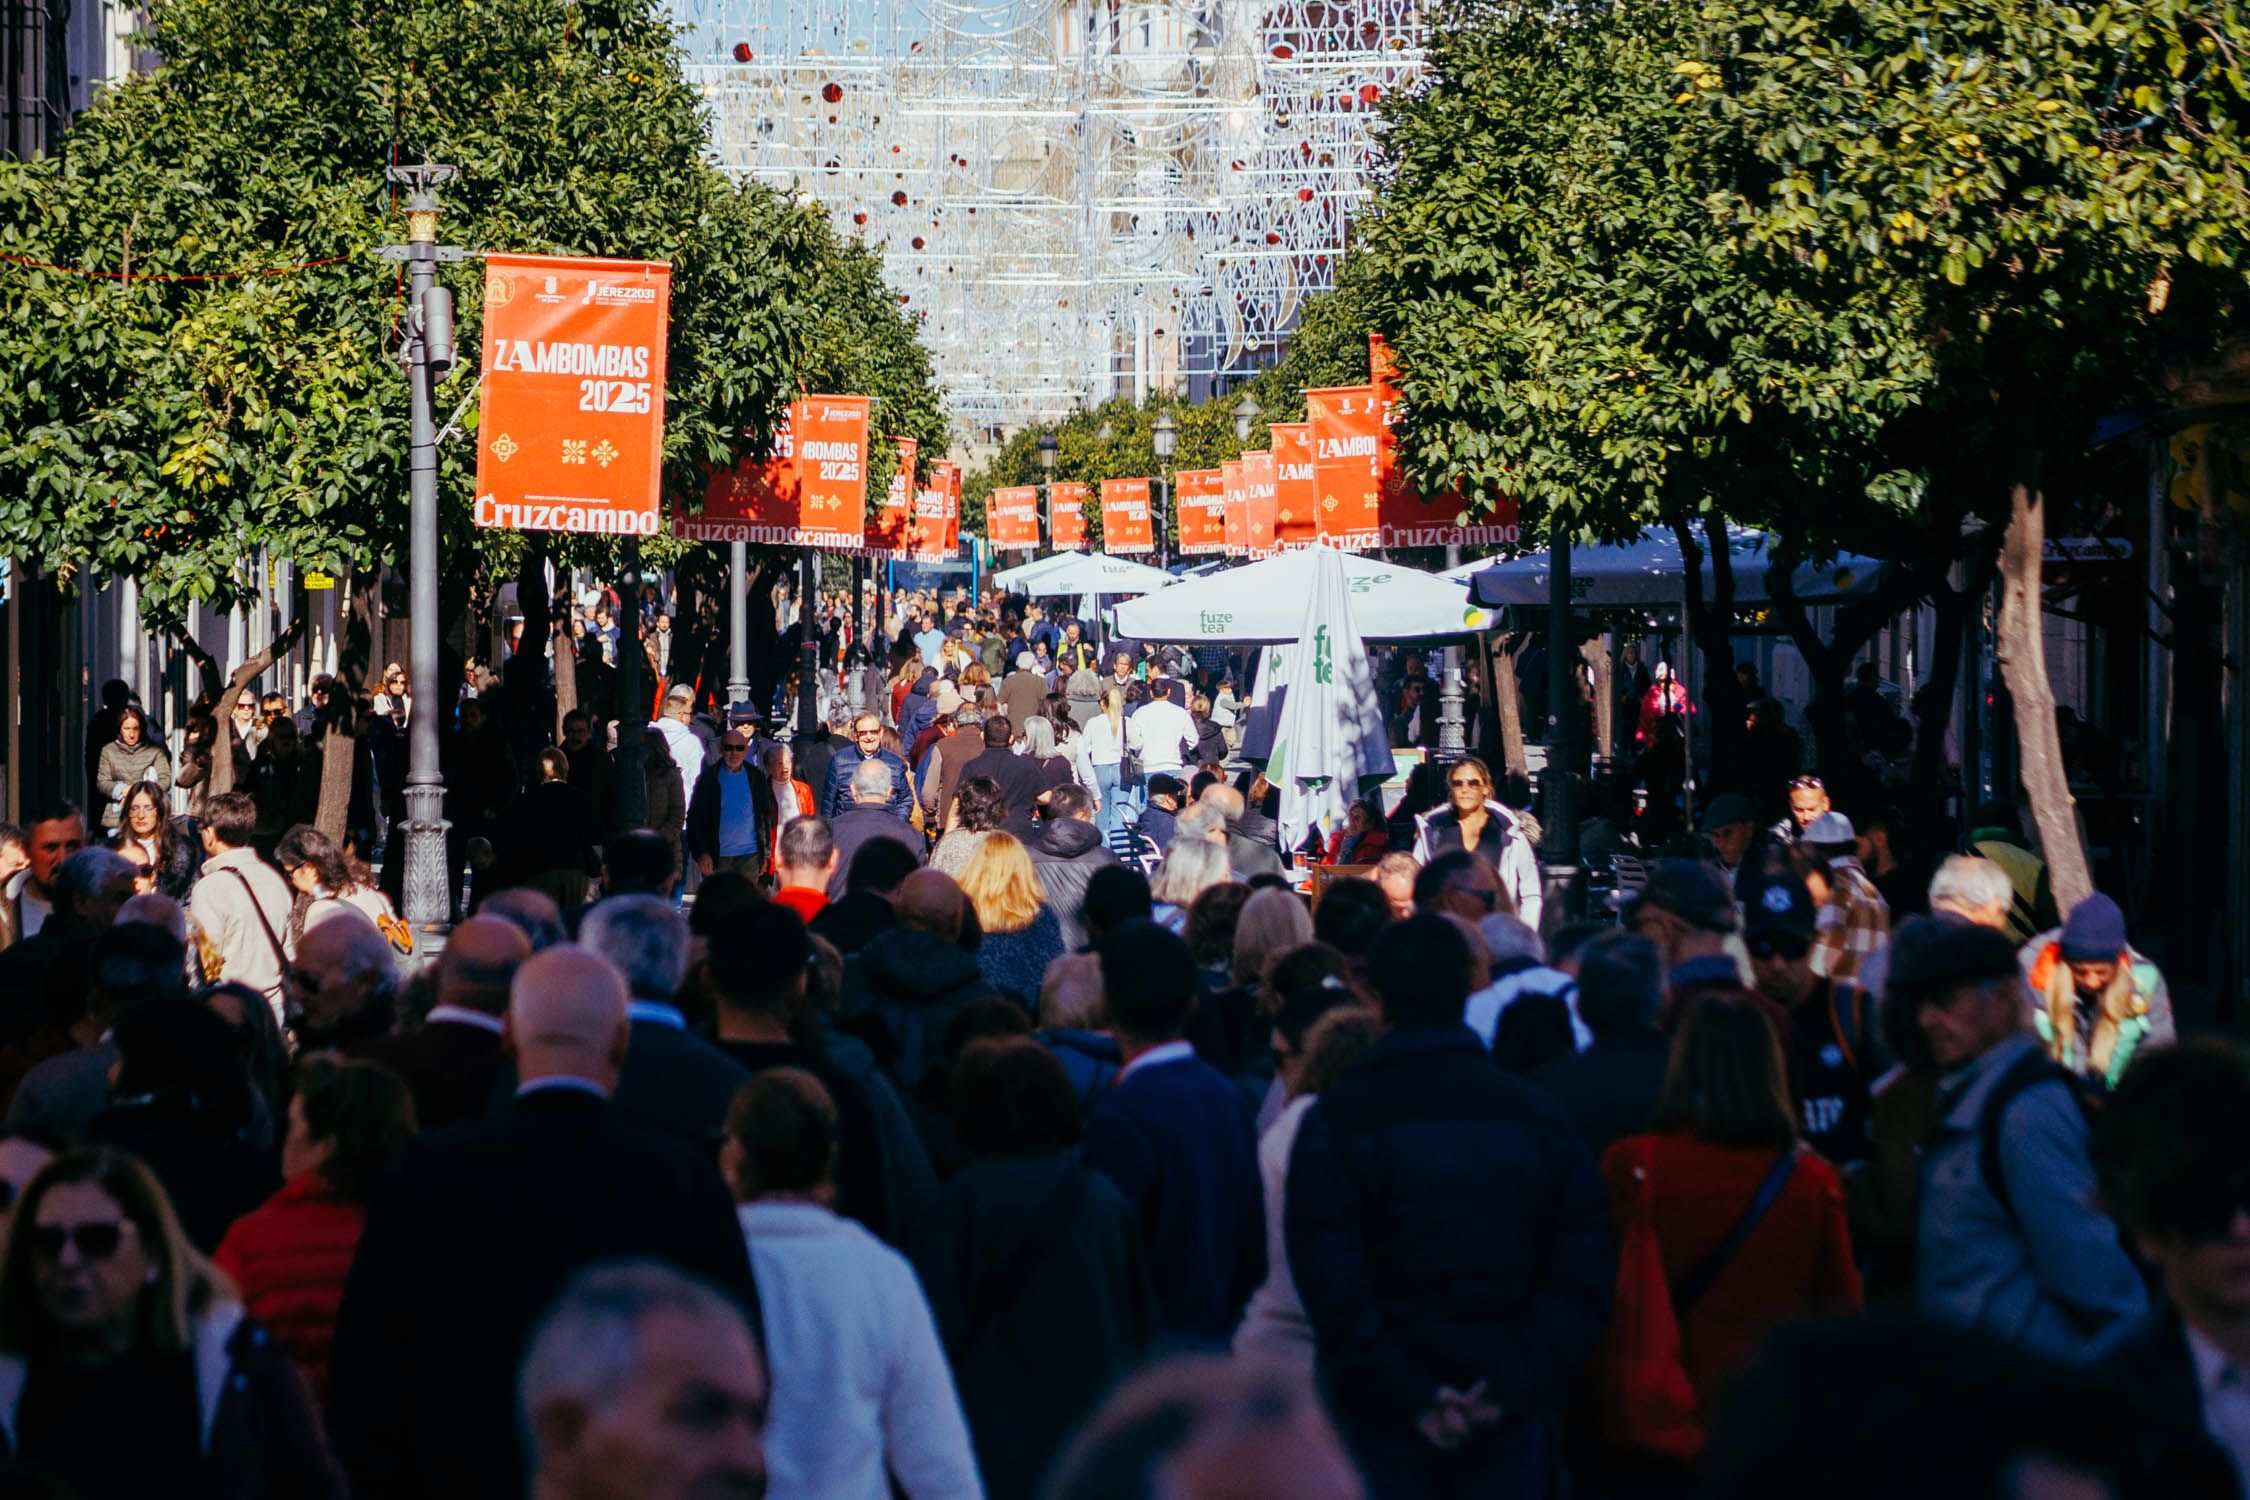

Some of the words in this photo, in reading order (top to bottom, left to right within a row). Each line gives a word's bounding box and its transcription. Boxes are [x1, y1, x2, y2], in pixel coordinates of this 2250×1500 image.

[493, 339, 649, 378] ZAMBOMBAS
[579, 380, 651, 414] 2025
[820, 461, 860, 480] 2025
[474, 494, 659, 535] Cruzcampo
[671, 516, 800, 543] Cruzcampo
[1380, 521, 1520, 549] Cruzcampo
[1200, 609, 1233, 623] fuze
[1200, 623, 1225, 633] tea
